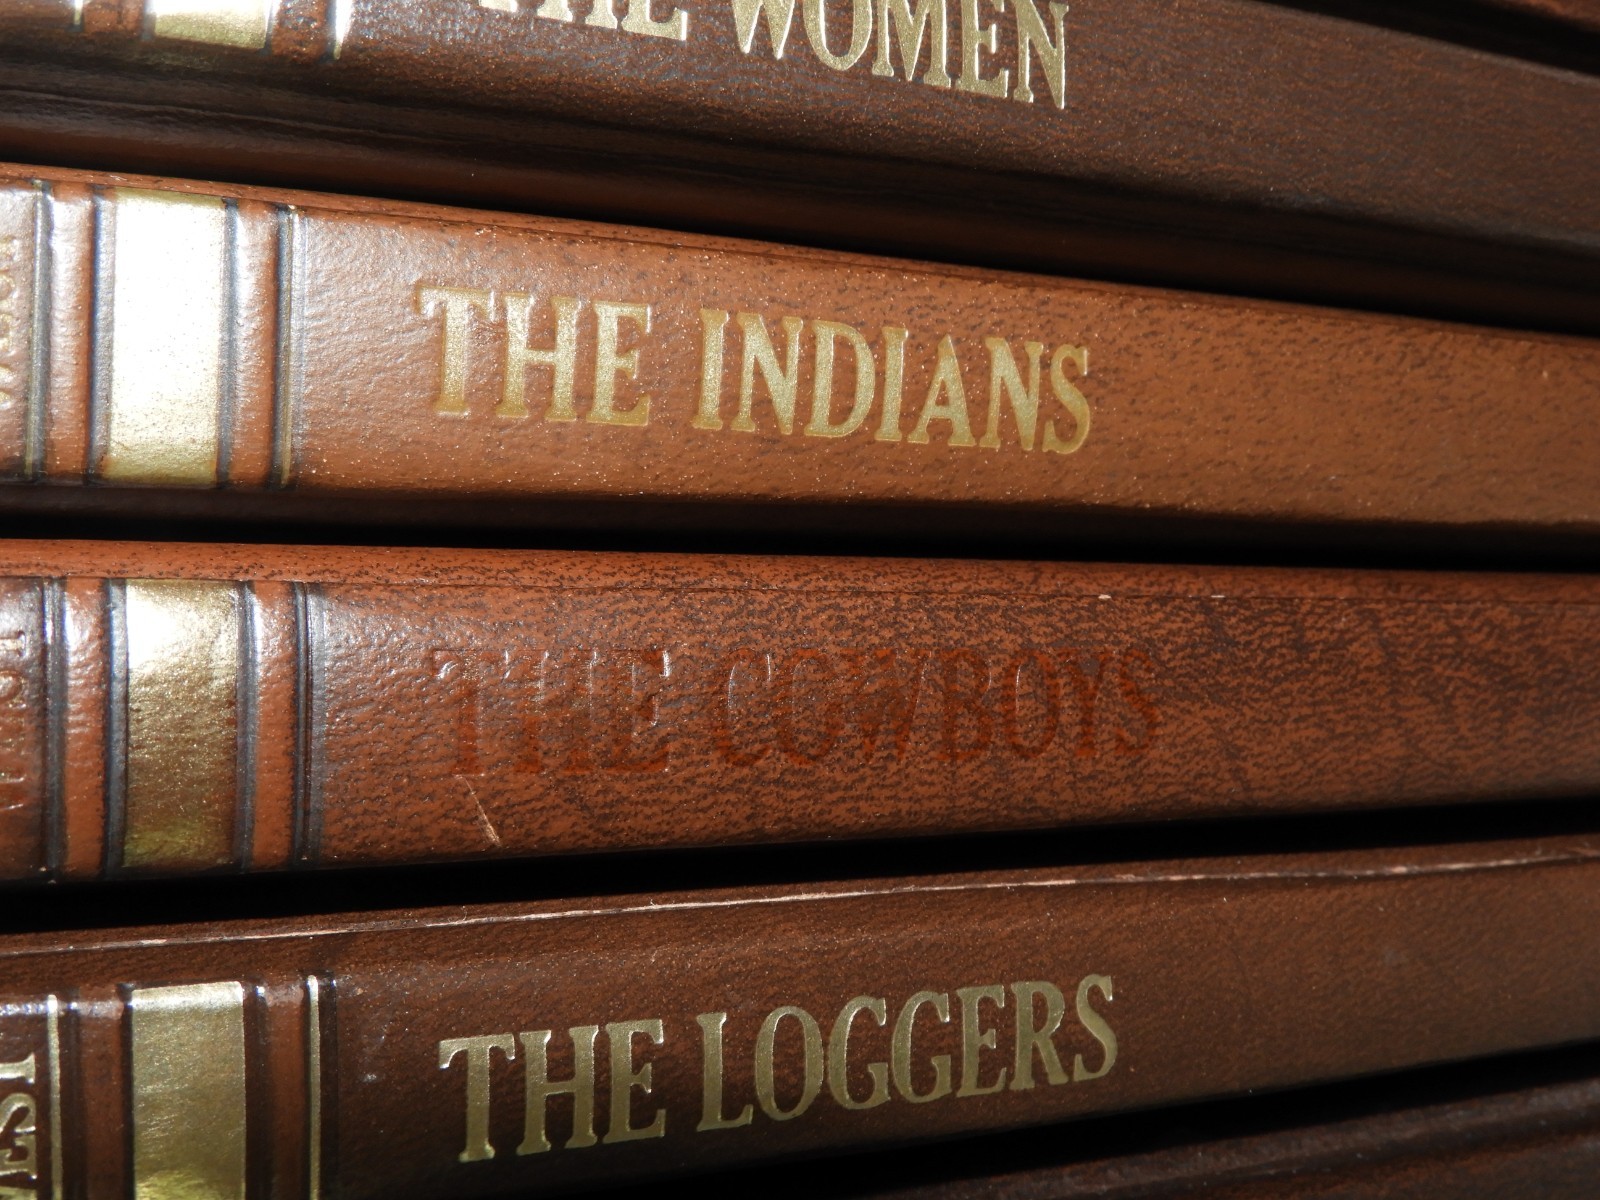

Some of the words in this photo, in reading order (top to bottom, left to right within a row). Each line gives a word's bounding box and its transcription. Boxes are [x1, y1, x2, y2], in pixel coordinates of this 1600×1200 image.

[415, 283, 652, 427] THE
[691, 308, 1092, 455] INDIANS
[430, 648, 671, 777] THE
[711, 646, 1159, 767] COWBOYS
[438, 1018, 665, 1162] THE
[696, 974, 1119, 1133] LOGGERS
